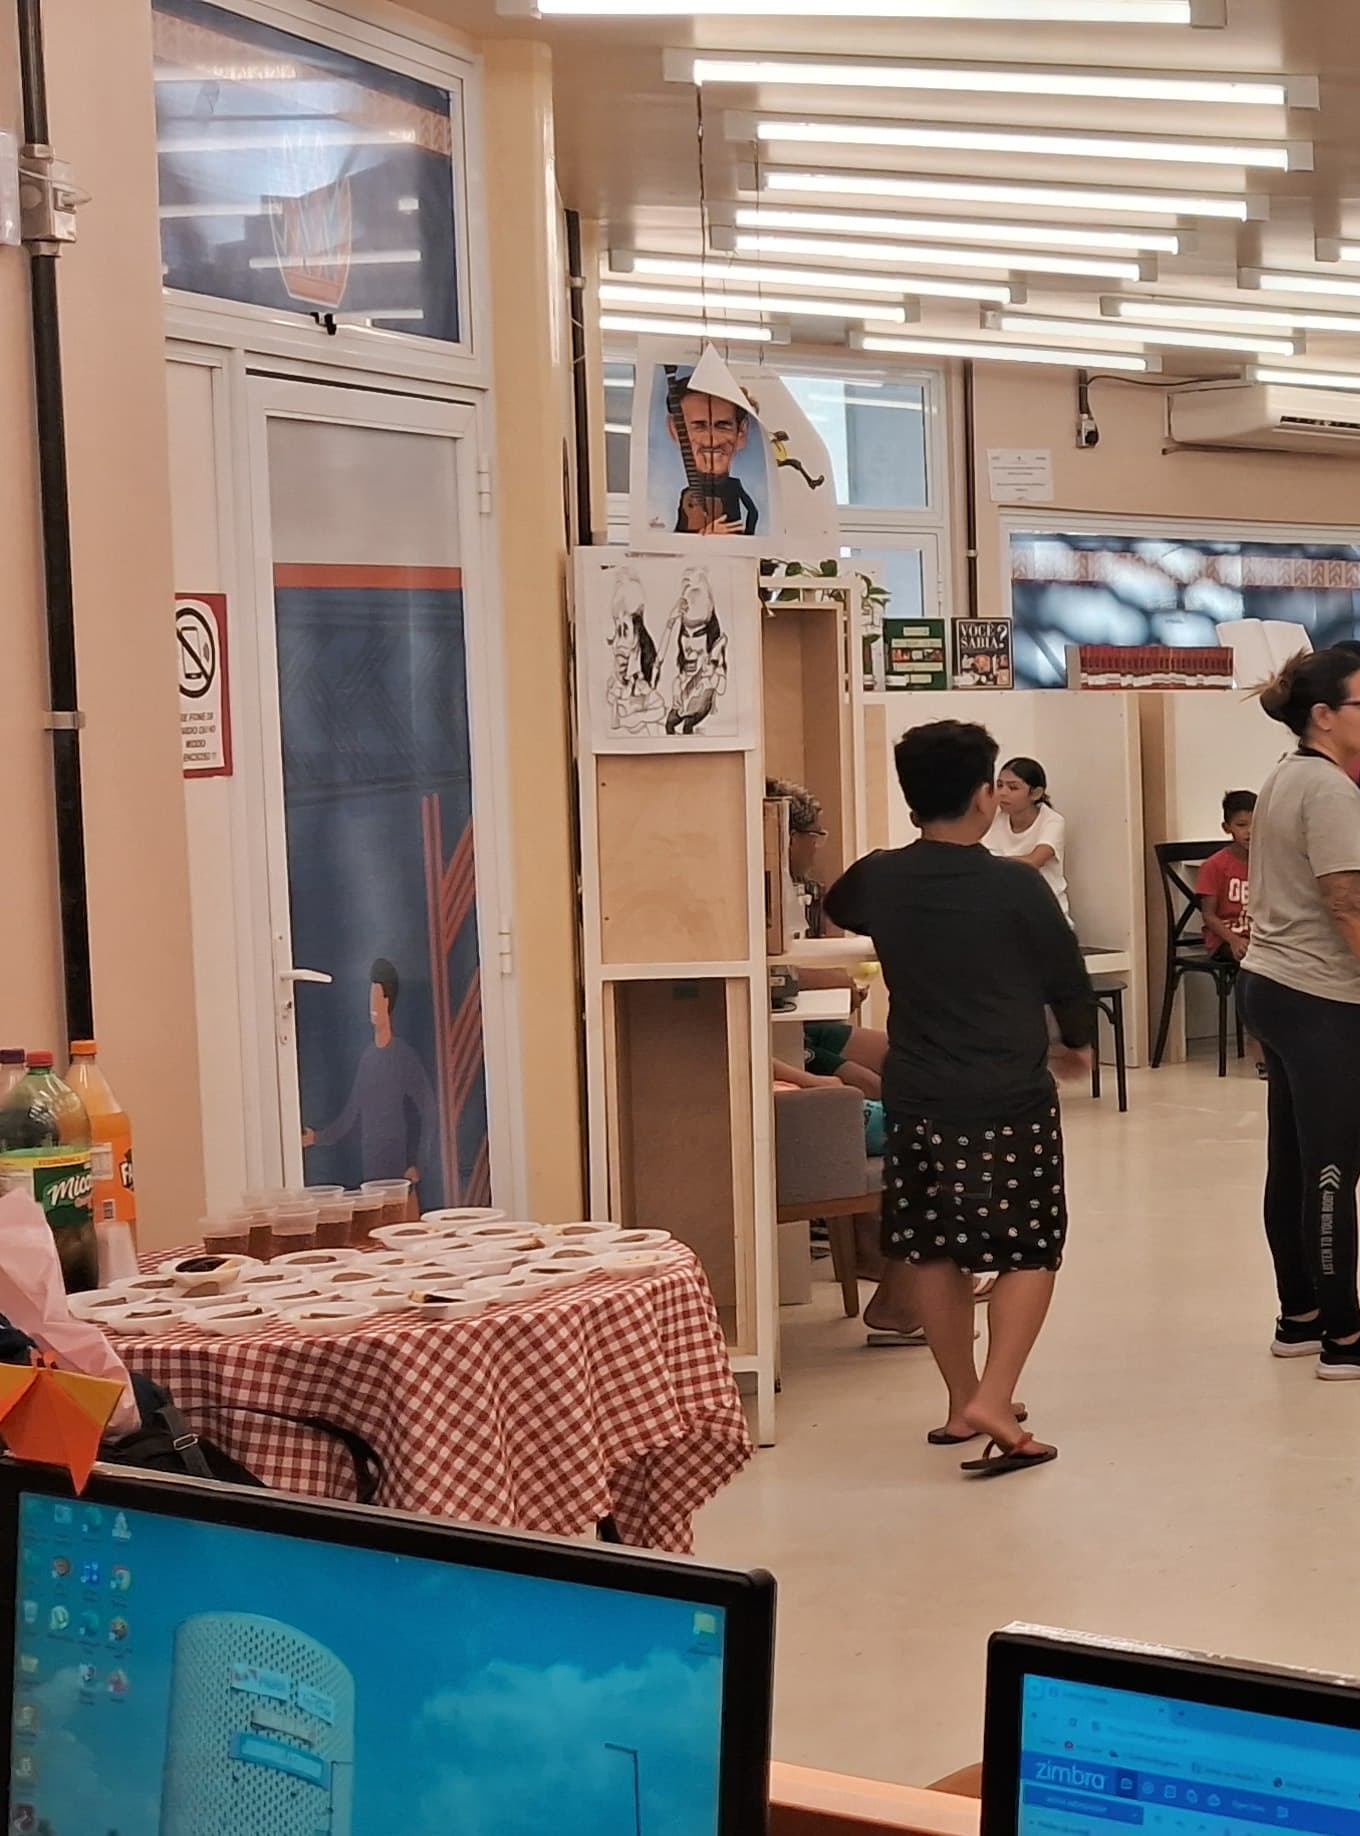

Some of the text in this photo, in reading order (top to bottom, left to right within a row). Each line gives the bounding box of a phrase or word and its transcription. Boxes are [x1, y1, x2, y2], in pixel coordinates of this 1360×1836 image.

[1321, 1190, 1335, 1275] LISTEN TO YOUR BODY
[1035, 1759, 1106, 1791] zimbra
